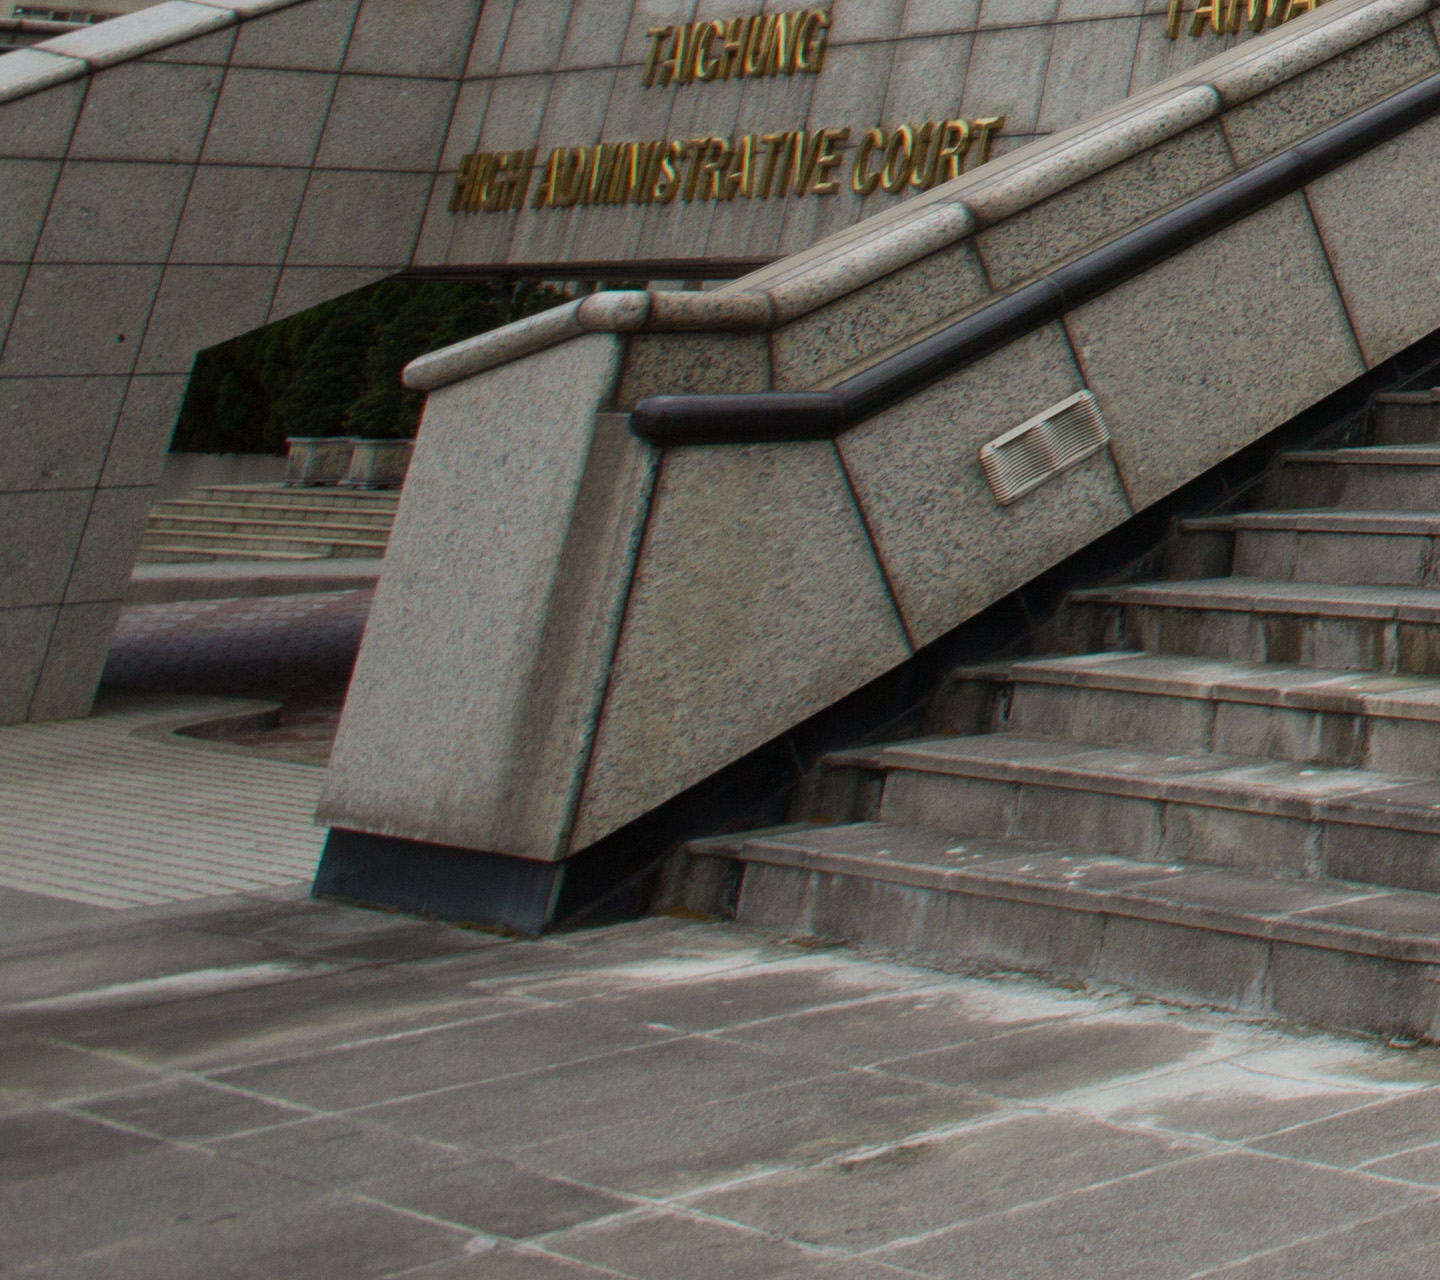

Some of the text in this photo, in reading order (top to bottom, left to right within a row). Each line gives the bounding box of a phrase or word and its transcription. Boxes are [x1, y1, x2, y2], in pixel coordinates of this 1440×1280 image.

[641, 9, 831, 88] TAICHUNG
[448, 115, 1006, 212] HIGH ADMINISTRATIVE COURT
